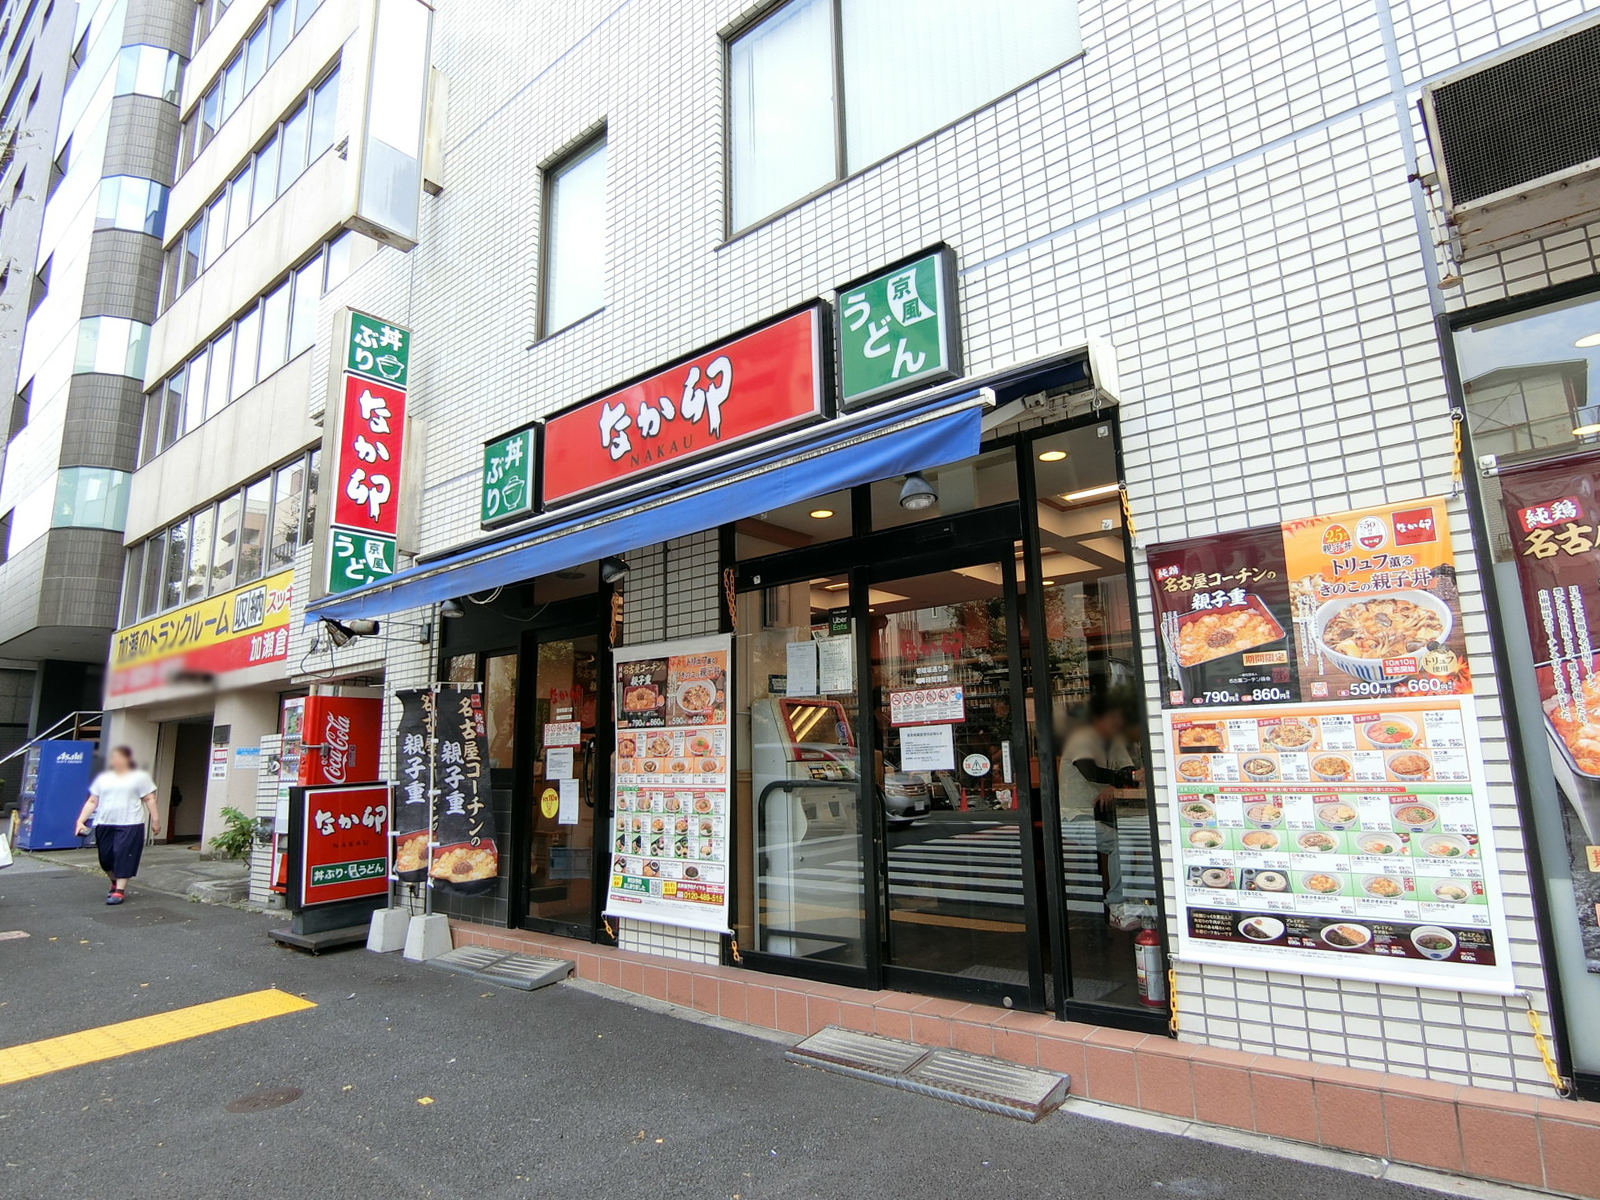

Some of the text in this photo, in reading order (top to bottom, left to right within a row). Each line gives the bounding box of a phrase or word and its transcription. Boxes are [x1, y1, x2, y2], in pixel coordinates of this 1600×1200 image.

[892, 276, 922, 323] 京風
[844, 292, 926, 378] うどん
[600, 356, 732, 461] なか卯
[345, 389, 392, 523] なか卯
[630, 435, 693, 467] NAKAU
[1396, 518, 1432, 533] なか卯
[1525, 499, 1577, 529] 純鶏
[1522, 523, 1600, 560] 名古
[335, 535, 375, 584] うど
[1332, 554, 1413, 576] トリュフ薫る
[1163, 567, 1276, 592] 名古屋コーチンの
[1320, 567, 1432, 596] きのこの親子丼
[235, 590, 264, 627] 収納
[1191, 588, 1248, 611] 親子重
[118, 600, 229, 663] 加瀬のトランクルーム
[832, 616, 848, 624] Uber
[833, 623, 848, 631] Eats
[1425, 656, 1454, 666] トリュフ
[403, 733, 426, 805] 親子重
[441, 741, 466, 816] 親子重
[458, 697, 484, 847] 名古屋コーチンの
[315, 805, 387, 837] なか卯
